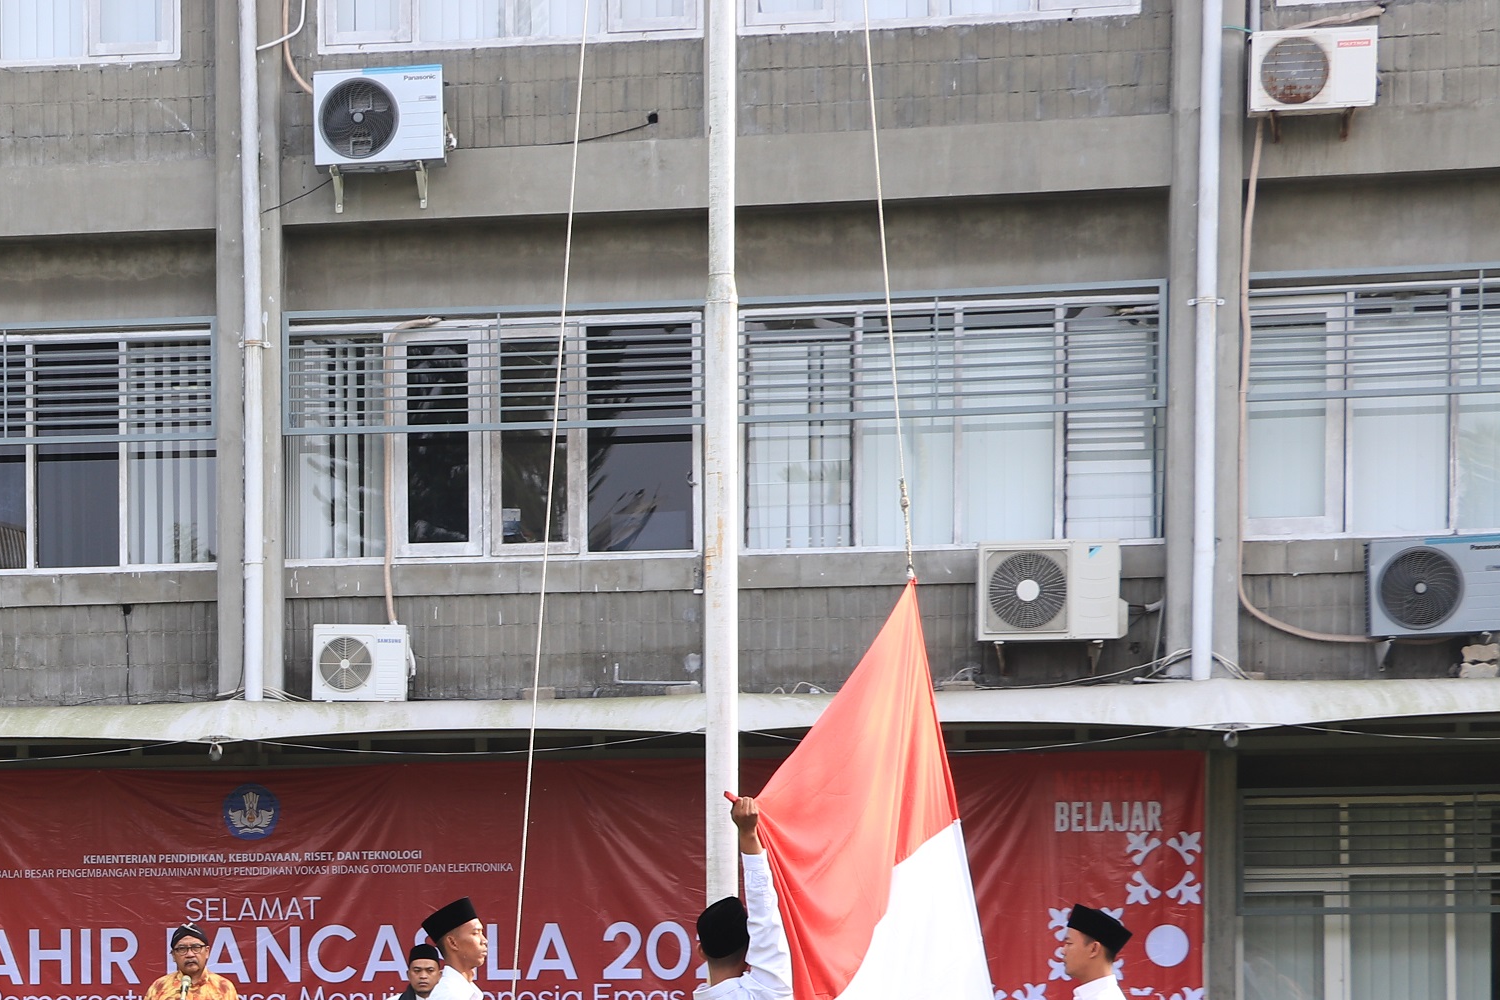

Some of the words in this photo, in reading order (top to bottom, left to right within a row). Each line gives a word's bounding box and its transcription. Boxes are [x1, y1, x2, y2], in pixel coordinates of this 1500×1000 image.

[1054, 801, 1163, 832] BELAJAR
[83, 855, 155, 864] KEMENTERIAN
[158, 854, 227, 864] PENDIDIKAN,
[228, 853, 302, 863] KEBUDAYAAN,
[304, 852, 335, 862] RISET,
[336, 851, 360, 861] DAN
[361, 850, 422, 860] TEKNOLOGI
[24, 869, 54, 878] BESAR
[56, 868, 137, 878] PENGEMBANGAN
[138, 867, 201, 877] PENJAMINAN
[202, 867, 232, 876] MUTU
[233, 866, 293, 876] PENDIDIKAN
[294, 866, 329, 875] VOKASI
[331, 865, 370, 875] BIDANG
[371, 864, 422, 874] OTOMOTIF
[424, 864, 447, 873] DAN
[448, 863, 514, 873] ELEKTRONIKA
[186, 897, 321, 922] SELAMAT
[166, 922, 579, 984] ANCALA
